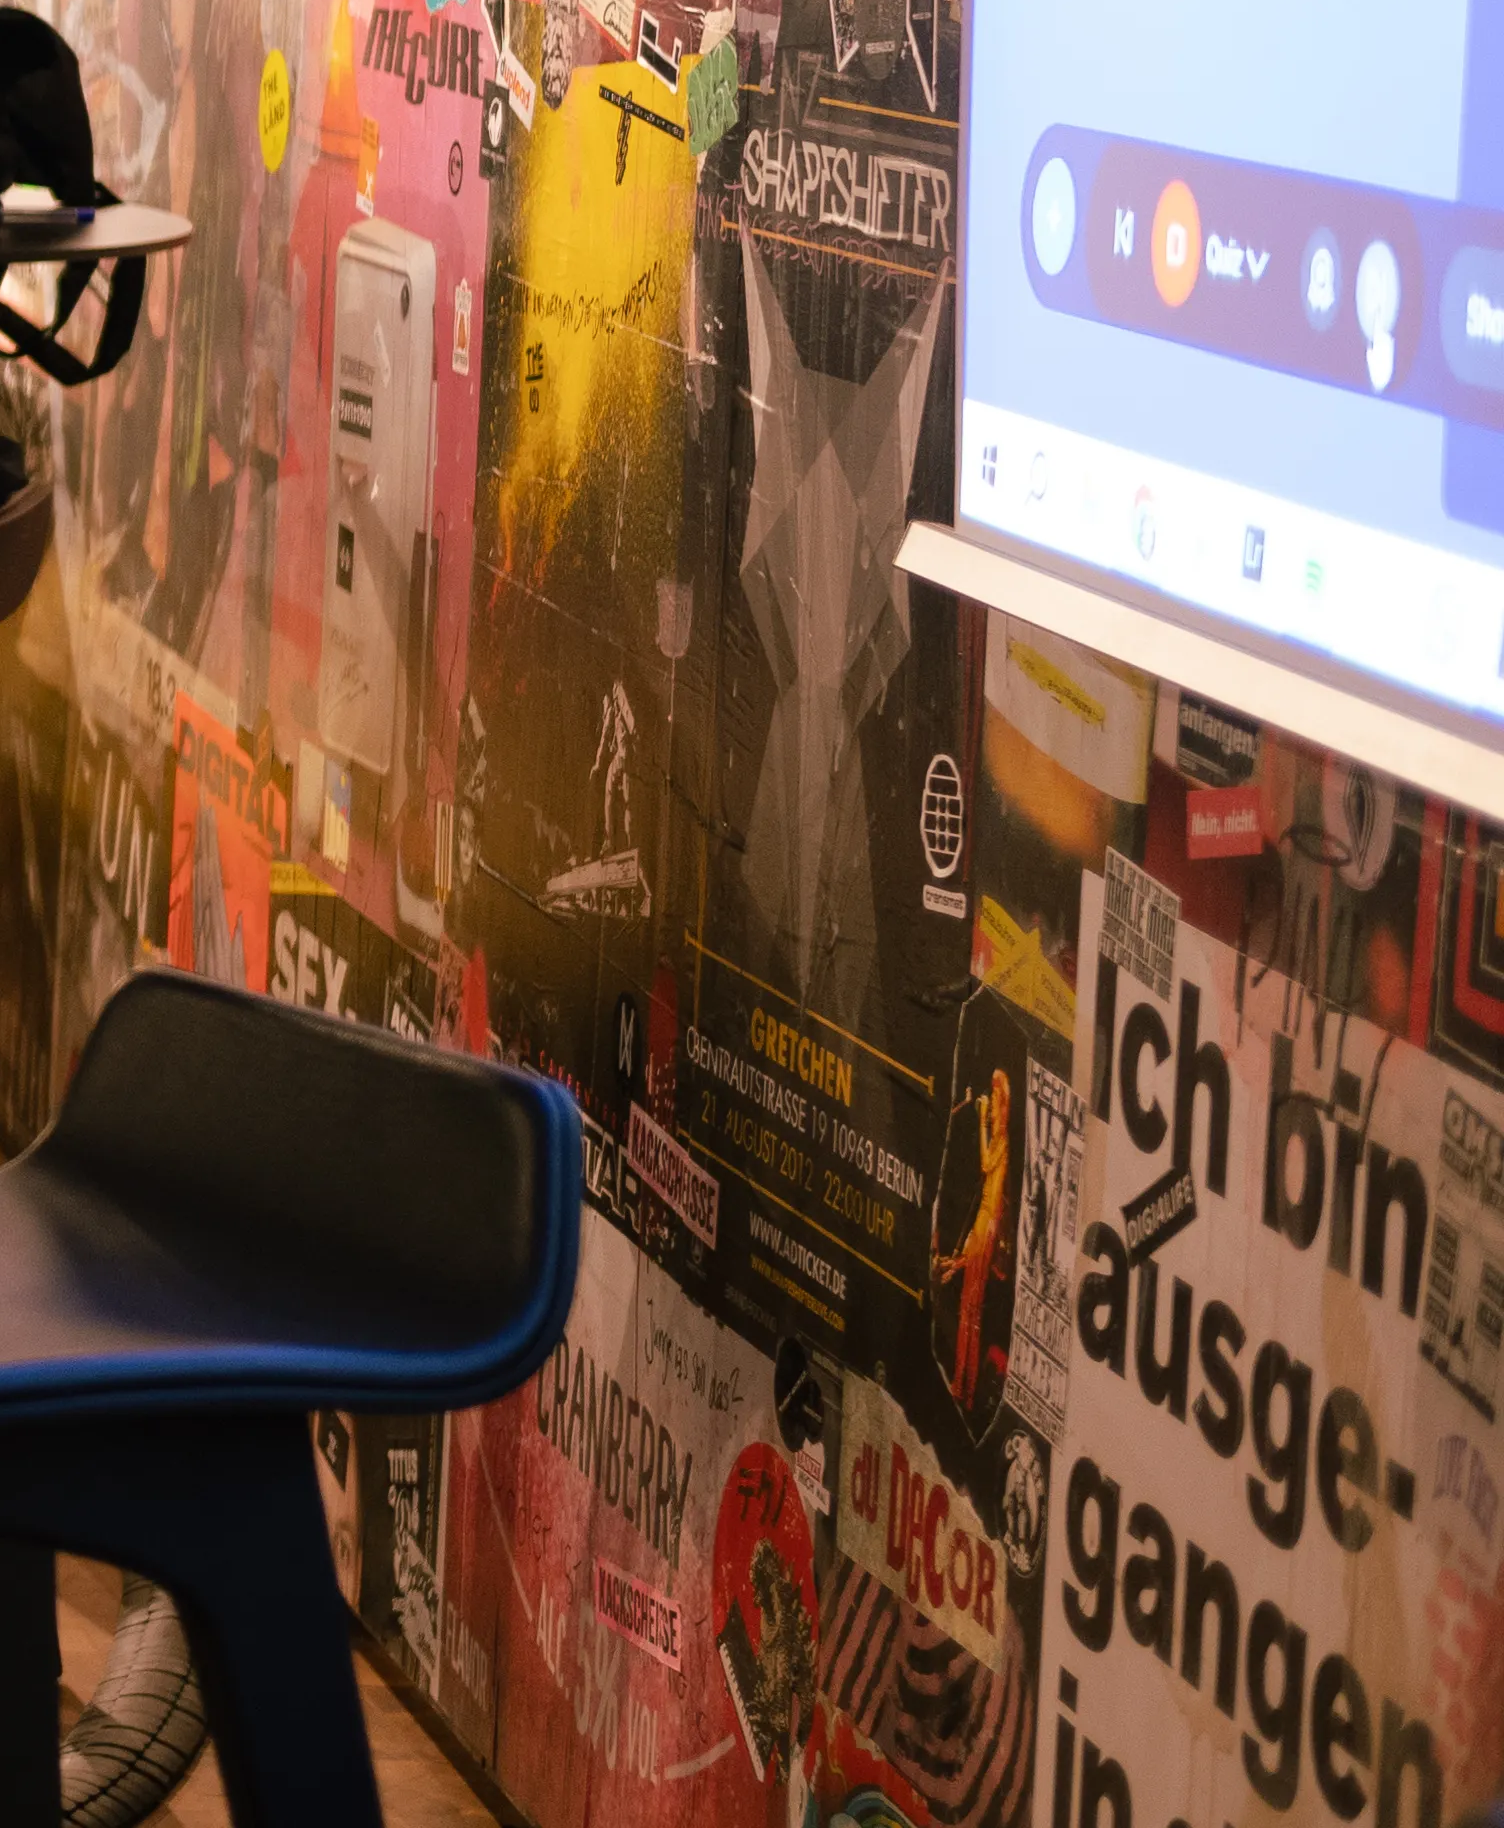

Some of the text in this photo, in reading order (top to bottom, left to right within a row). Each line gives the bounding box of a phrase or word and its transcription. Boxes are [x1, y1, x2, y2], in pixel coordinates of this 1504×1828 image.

[263, 70, 278, 101] THE
[263, 97, 286, 135] LAND
[404, 16, 486, 106] CURE
[743, 128, 951, 253] SHAPESHIFTER
[1205, 231, 1246, 278] Quiz
[178, 718, 286, 857] DIGITAL
[1191, 811, 1222, 839] Nein,
[750, 1006, 852, 1108] GRETCHEN
[686, 1025, 925, 1209] OBENTRAUTSTRASSE 19 10963 BERLIN
[1095, 965, 1430, 1320] Ich bin
[630, 1113, 716, 1237] KACKSCHEISSE
[725, 1109, 779, 1167] AUGUST
[779, 1139, 814, 1193] 2012
[822, 1169, 865, 1228] 22:00
[864, 1202, 896, 1250] UHR
[748, 1209, 848, 1301] WWW.ADTICKET.DE
[1077, 1212, 1417, 1555] ausge-
[537, 1335, 693, 1573] CRANBERRY
[598, 1567, 679, 1659] KACKSCHEISSE
[1059, 1454, 1444, 1828] gangen
[627, 1696, 660, 1786] VOL
